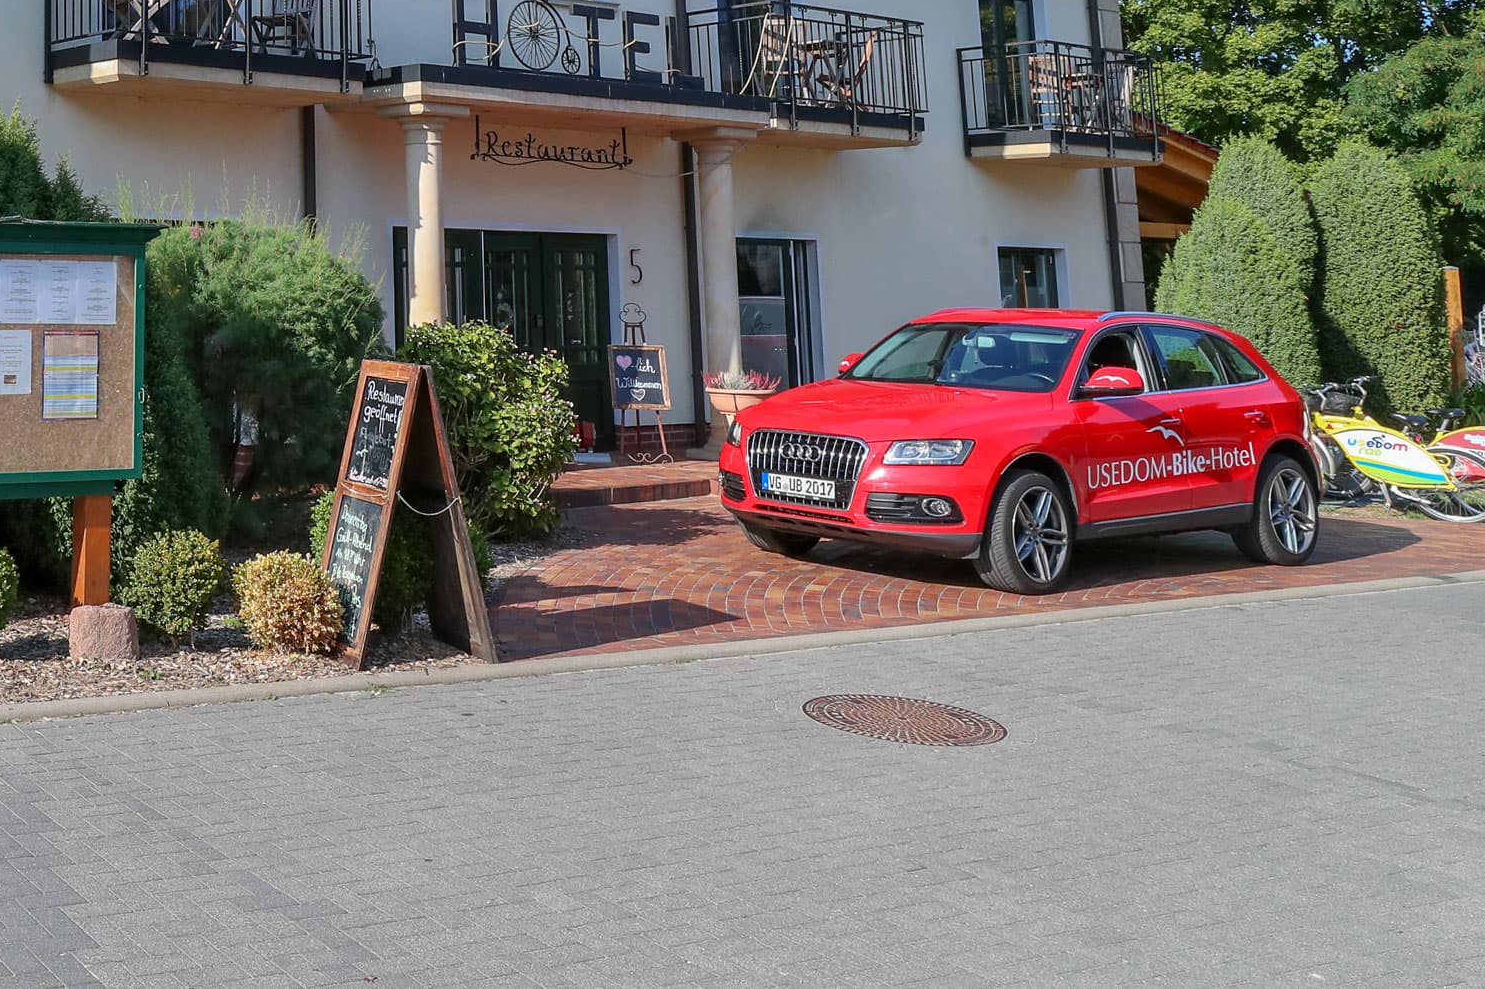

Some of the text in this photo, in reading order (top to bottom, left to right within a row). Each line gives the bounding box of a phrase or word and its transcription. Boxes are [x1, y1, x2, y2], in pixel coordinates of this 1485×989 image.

[485, 131, 621, 164] Restaurant
[630, 248, 643, 285] 5
[1087, 441, 1256, 490] USEDOM-Bike-Hotel
[769, 475, 834, 497] VG UB 2017
